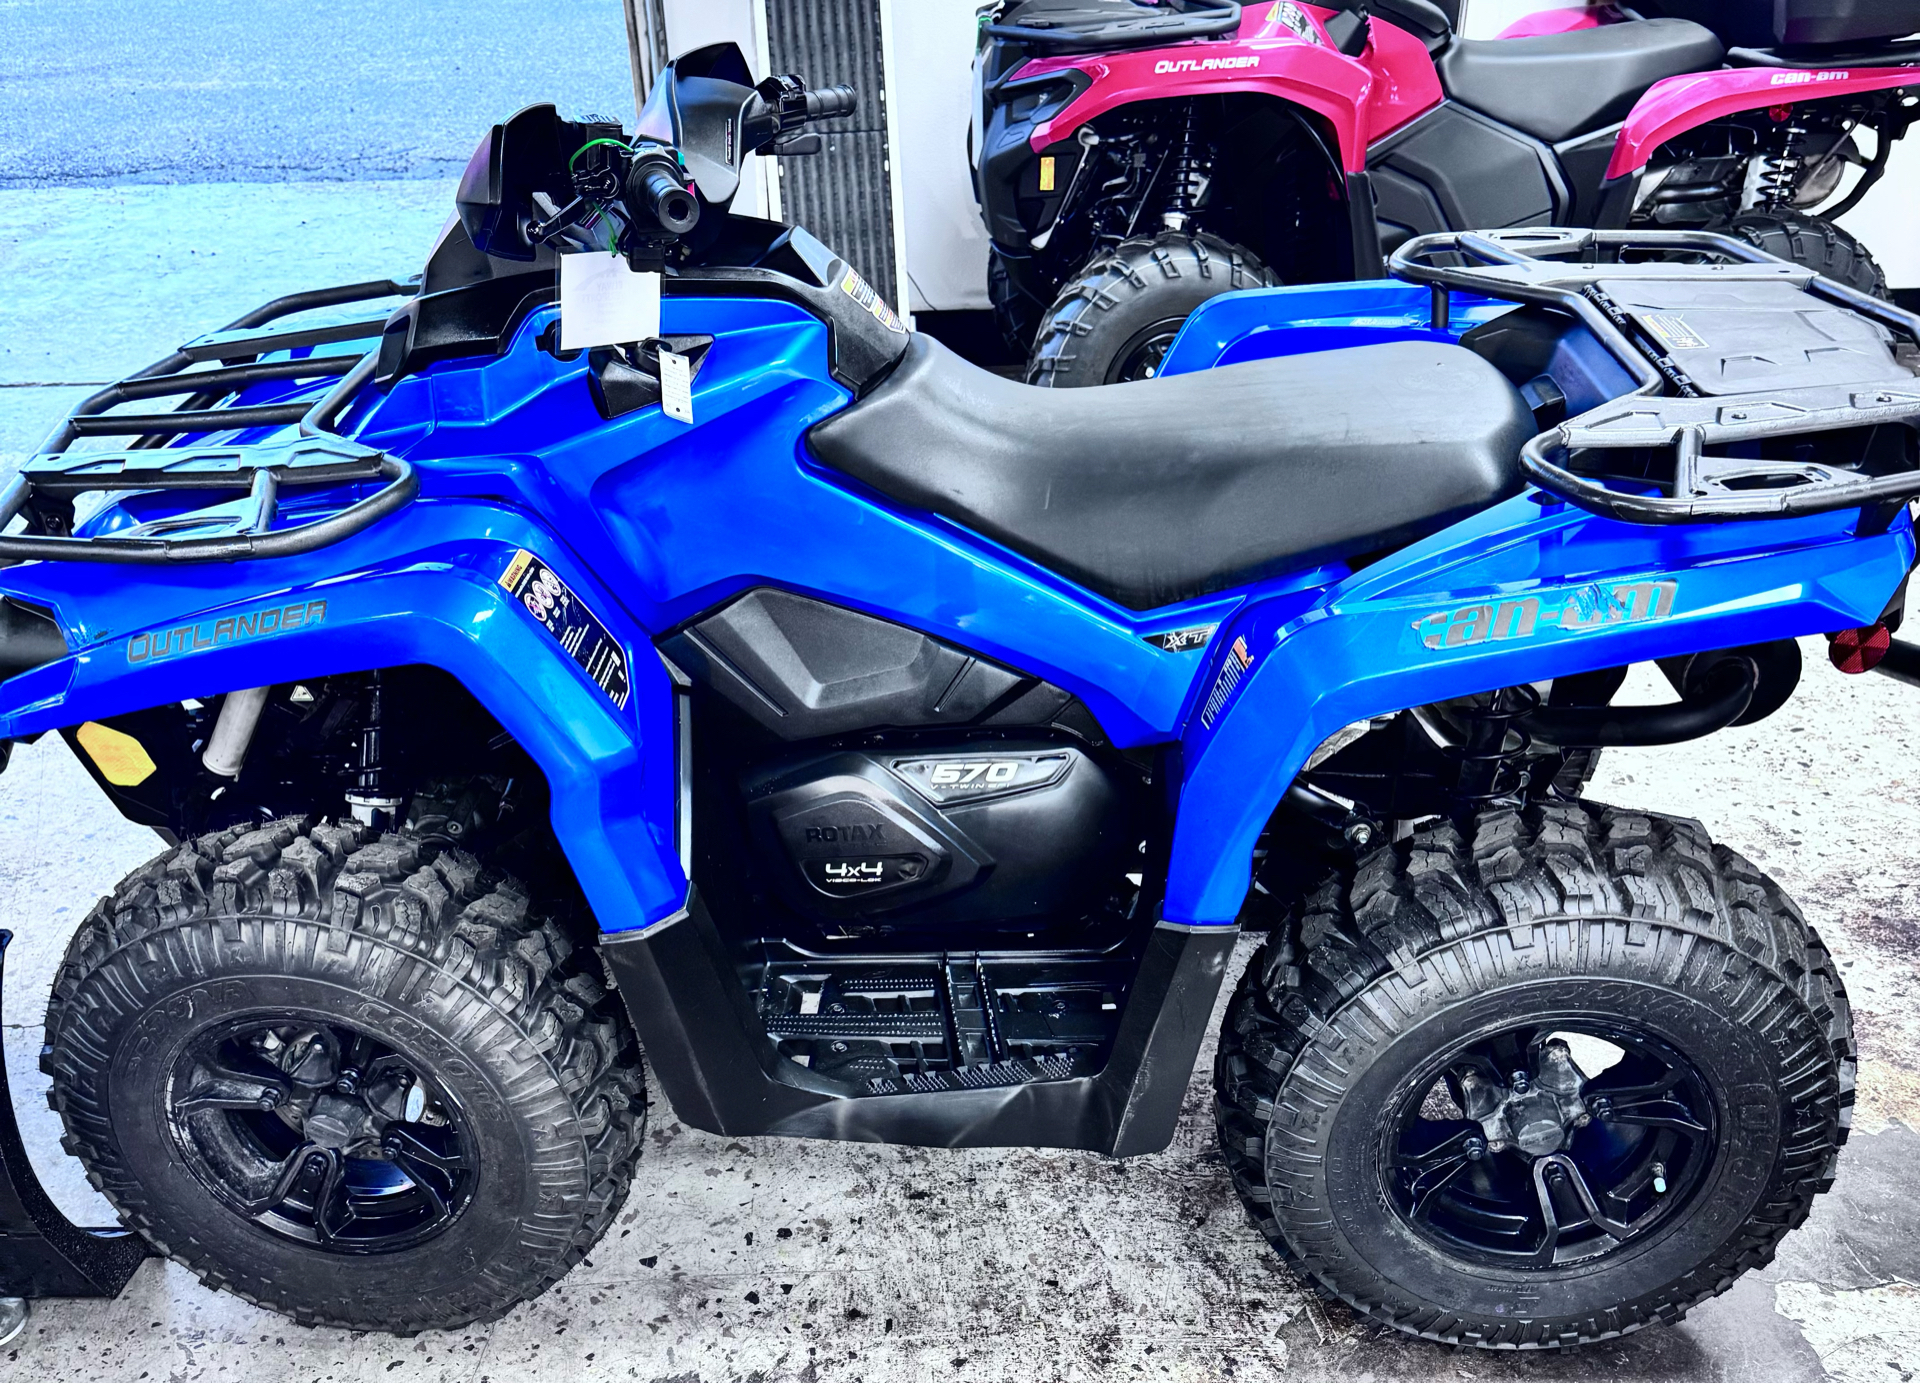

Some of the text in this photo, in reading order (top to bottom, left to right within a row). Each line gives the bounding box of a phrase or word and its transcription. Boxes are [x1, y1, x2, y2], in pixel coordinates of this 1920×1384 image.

[1154, 56, 1260, 74] OUTLANDER
[1770, 71, 1849, 85] can-am
[128, 600, 328, 663] OUTLANDER
[1164, 626, 1215, 653] XT
[930, 762, 1019, 783] 570
[805, 822, 886, 842] ROTAX
[825, 861, 884, 877] 4x4
